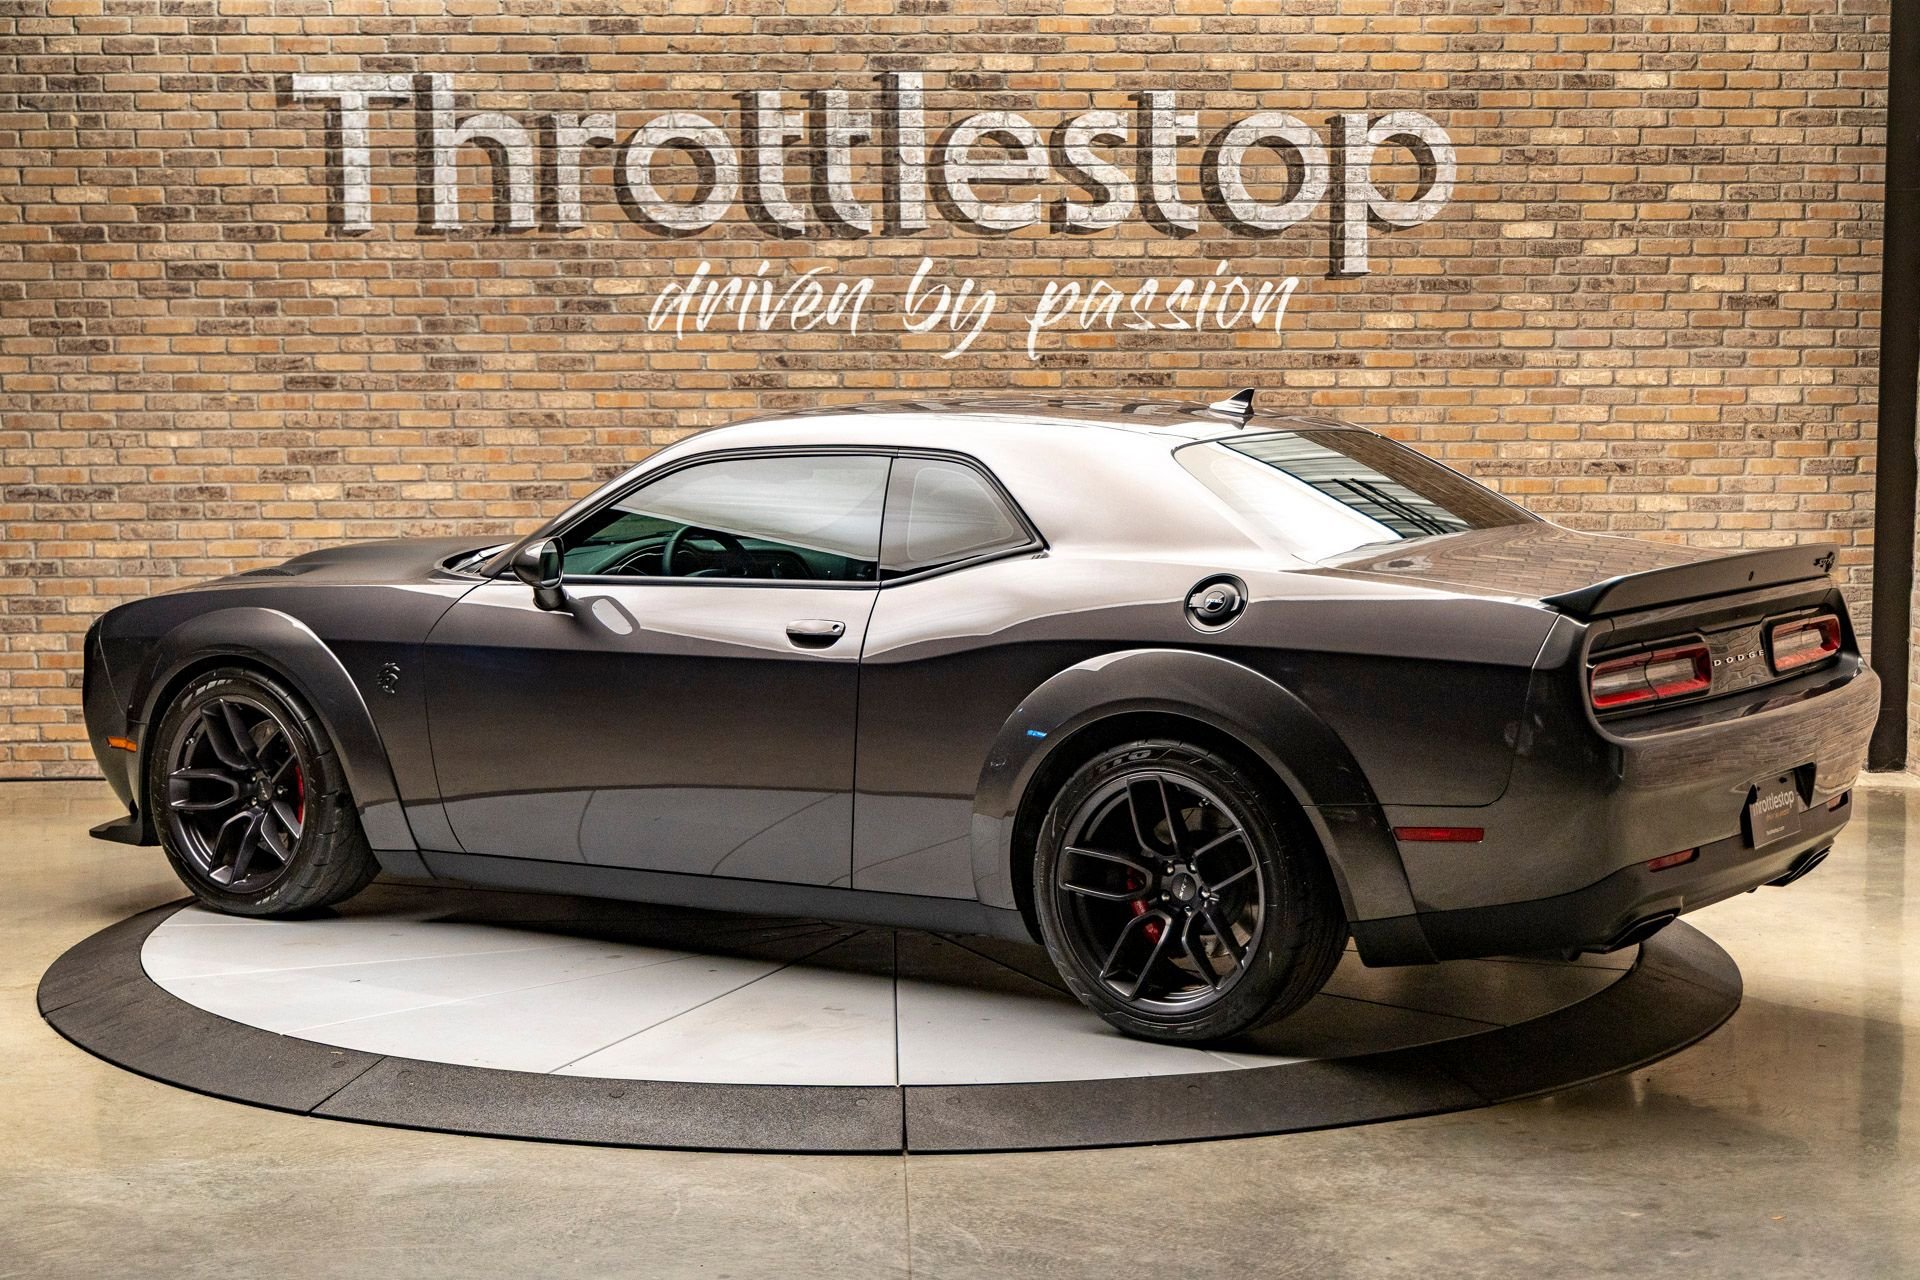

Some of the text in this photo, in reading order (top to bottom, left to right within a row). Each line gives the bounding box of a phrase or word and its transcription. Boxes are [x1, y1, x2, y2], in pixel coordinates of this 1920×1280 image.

[279, 70, 1457, 279] Throttlestop
[648, 256, 1299, 361] driven by passion
[1712, 649, 1765, 667] DODGE
